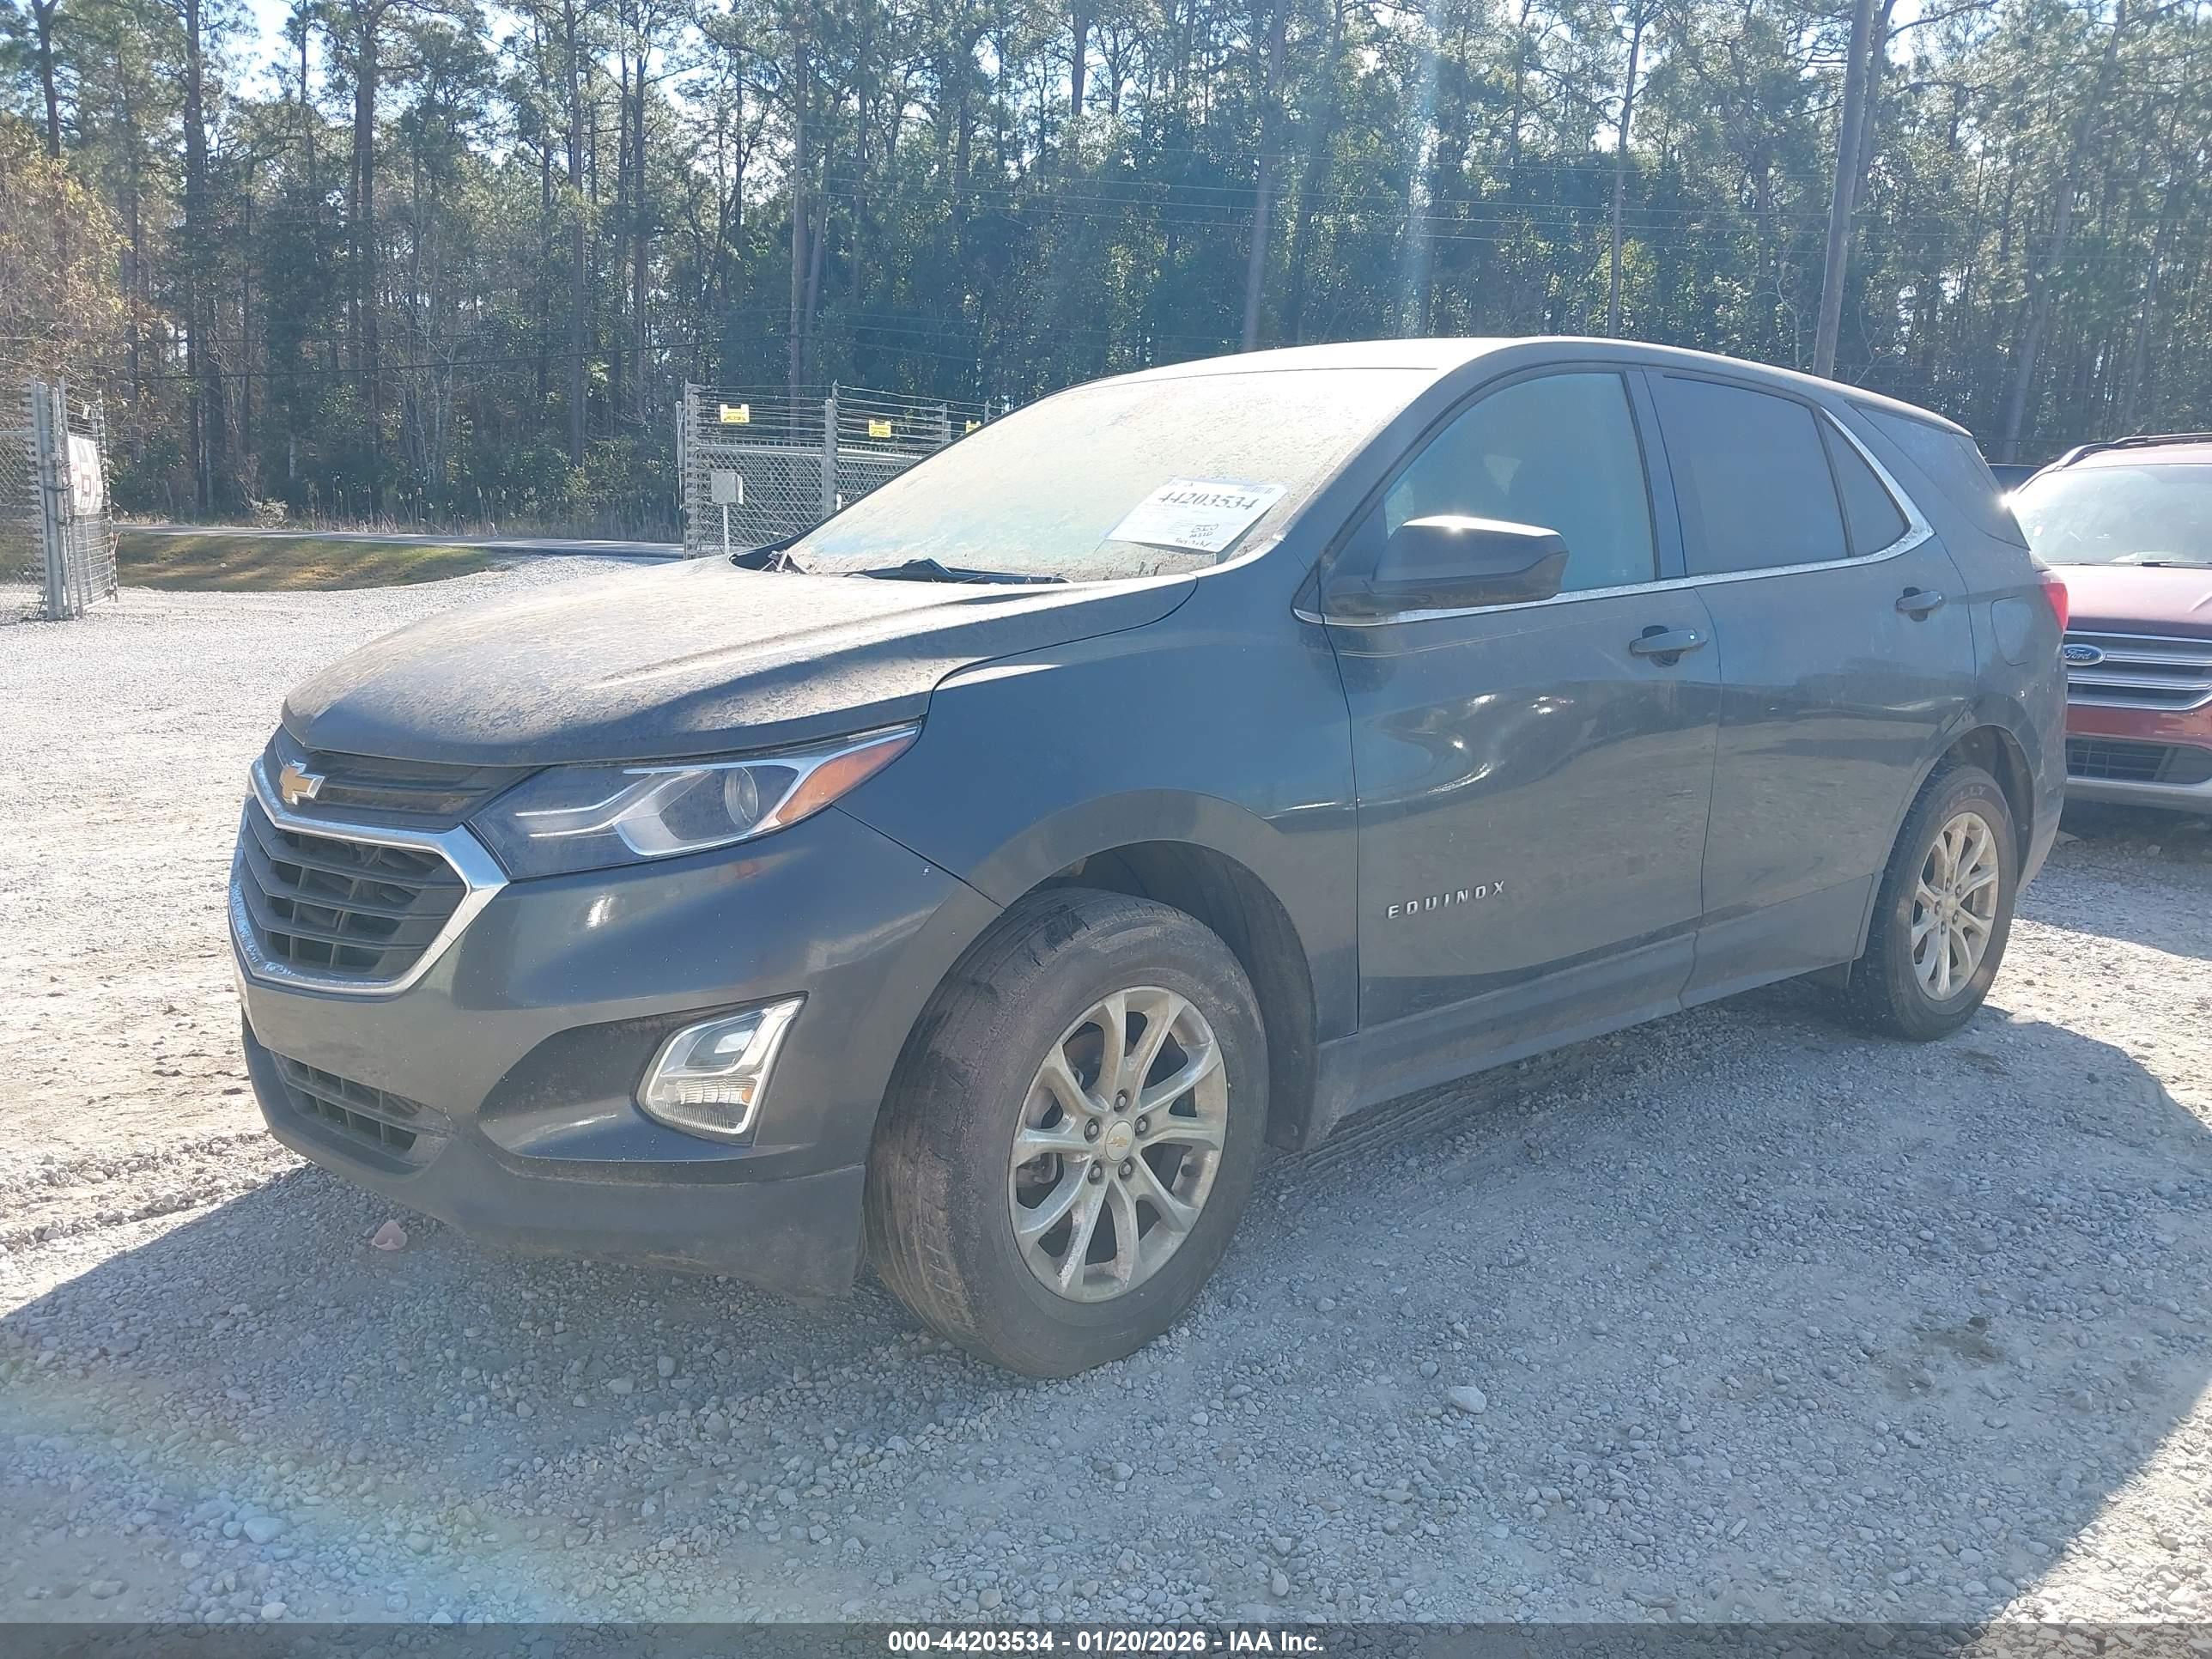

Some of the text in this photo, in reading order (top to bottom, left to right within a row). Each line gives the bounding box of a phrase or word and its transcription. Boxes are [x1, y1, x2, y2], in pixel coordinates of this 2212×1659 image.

[1158, 491, 1260, 510] 44203534
[2064, 648, 2092, 660] Ford
[1387, 880, 1504, 919] EQUINOX
